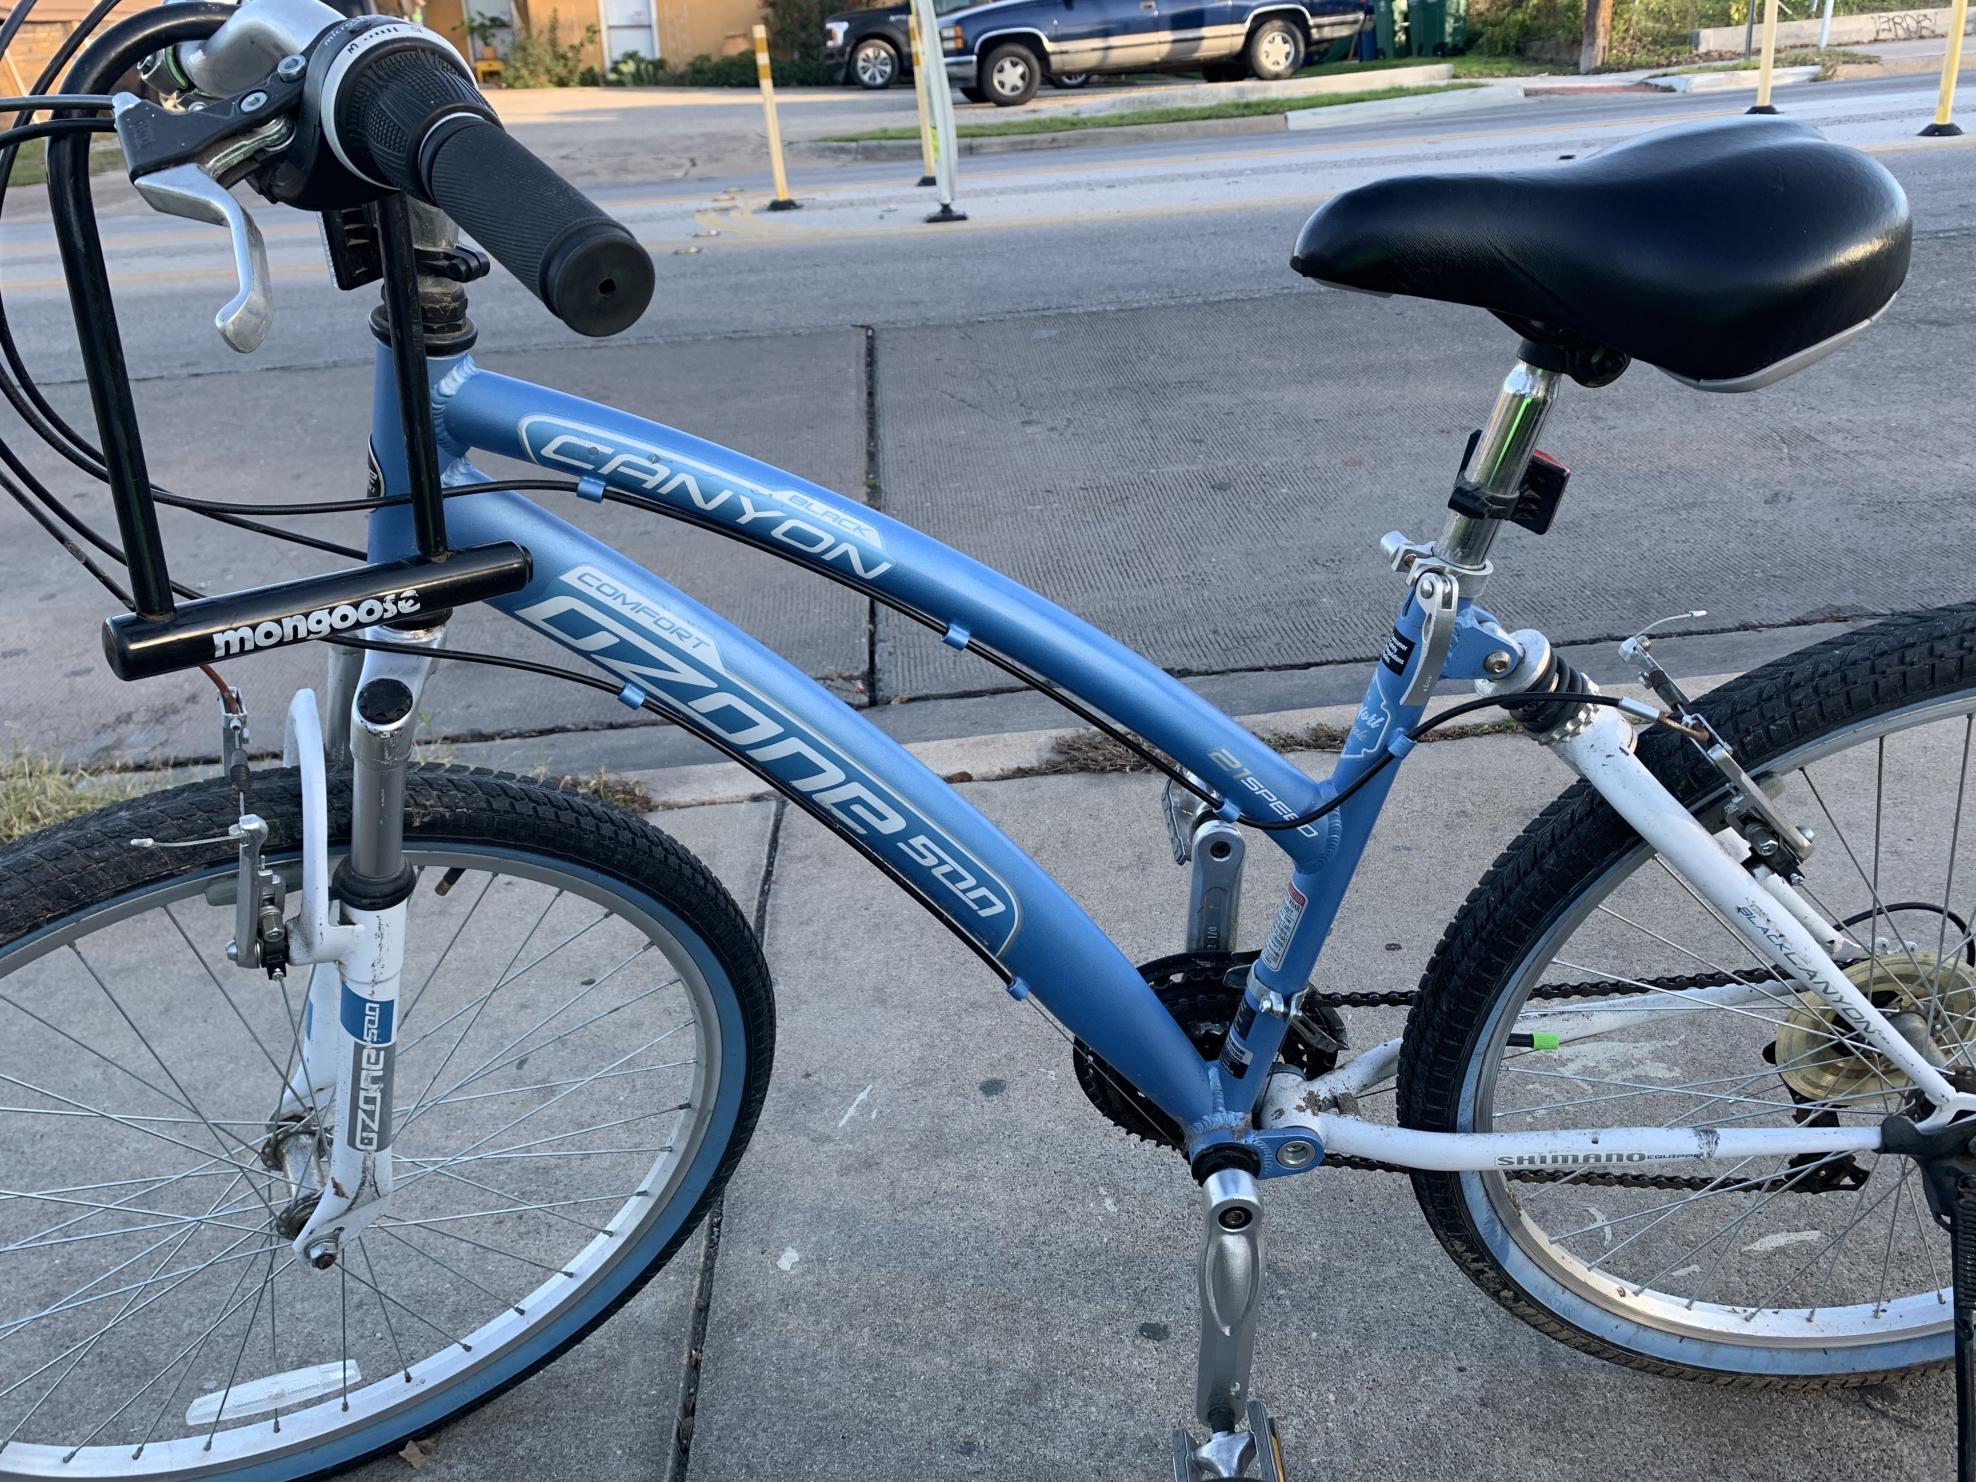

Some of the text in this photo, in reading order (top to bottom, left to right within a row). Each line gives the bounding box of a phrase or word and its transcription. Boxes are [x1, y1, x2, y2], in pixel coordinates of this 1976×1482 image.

[540, 434, 892, 580] CANYON
[788, 494, 875, 537] BLACK
[213, 589, 421, 658] mongoose
[576, 572, 711, 650] COMFORT
[897, 834, 1006, 918] 500
[1737, 905, 1792, 952] BLACK
[1496, 1152, 1647, 1167] SHIMANO
